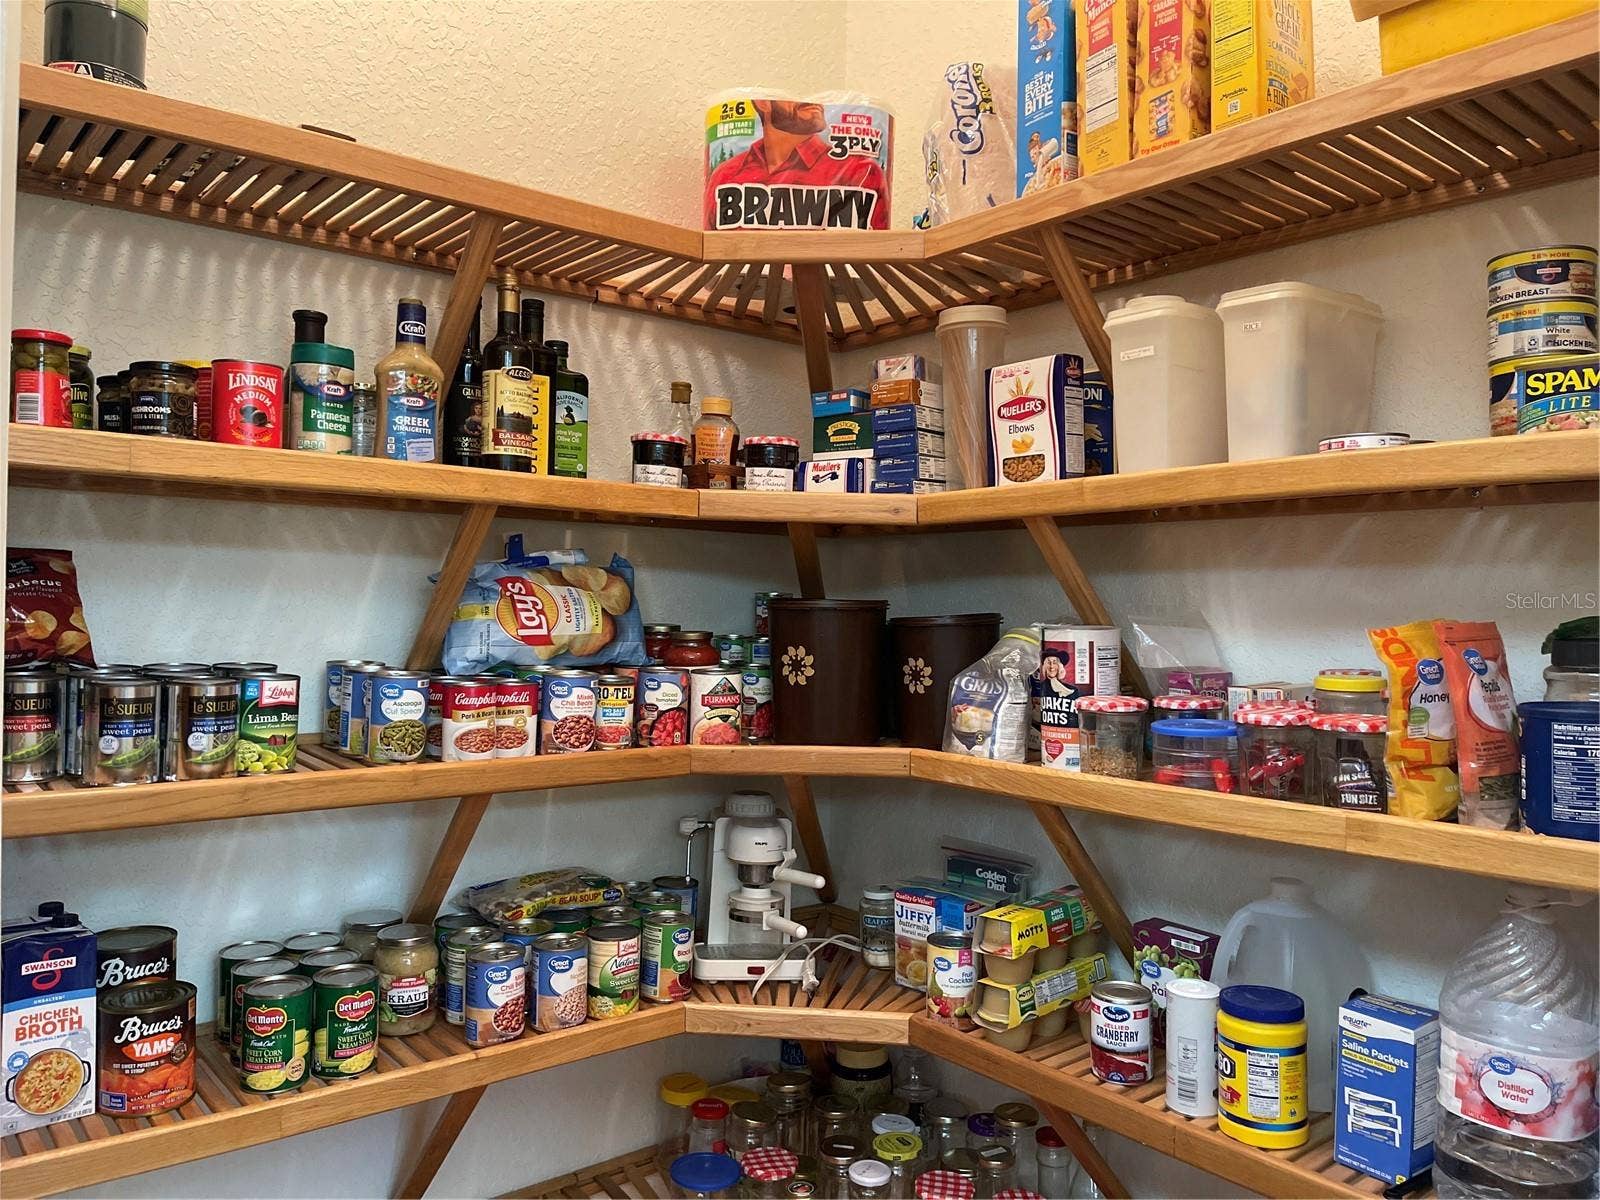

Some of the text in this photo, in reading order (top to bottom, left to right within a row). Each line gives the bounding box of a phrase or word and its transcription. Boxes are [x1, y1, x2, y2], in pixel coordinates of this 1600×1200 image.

[1025, 76, 1044, 92] BEST
[1045, 71, 1053, 83] IN
[1025, 80, 1053, 102] EVERY
[1025, 90, 1053, 116] BITE
[831, 125, 881, 138] THE ONLY
[829, 136, 880, 157] 3PLY
[717, 186, 875, 229] BRAWNY
[1515, 288, 1550, 298] BREAST
[404, 323, 424, 334] Kraft
[1527, 367, 1600, 396] SPAM
[326, 386, 345, 394] Kraft
[233, 391, 273, 408] MEDIUM
[406, 398, 421, 406] Kraft
[1549, 395, 1592, 413] LITE
[1000, 400, 1043, 418] MUELLER'S
[317, 419, 347, 432] Cheese
[395, 416, 430, 428] GREEK
[392, 424, 432, 435] VINAIGRETTE
[1008, 424, 1035, 435] Elbows
[812, 463, 840, 472] Mueller's
[8, 578, 62, 589] arbecue
[506, 582, 549, 636] Lay's
[561, 594, 573, 624] CLASSIC
[1420, 665, 1439, 674] Great
[266, 685, 295, 699] Libby's
[960, 677, 1002, 695] GRITS
[15, 699, 51, 711] SUEUR
[1420, 693, 1450, 704] Honey
[117, 702, 153, 715] SUEUR
[206, 701, 236, 712] SUEUR
[248, 714, 278, 724] Lima
[1042, 711, 1068, 725] OATS
[30, 723, 52, 732] peas
[102, 728, 152, 736] sweet peas
[191, 724, 236, 733] sweet peas
[1341, 793, 1378, 805] FUN SIZE
[976, 868, 1007, 883] Golden
[987, 880, 1007, 892] Dipt
[558, 893, 599, 905] BEAN SOUP
[895, 891, 912, 901] Quality
[896, 905, 933, 924] JIFFY
[1051, 907, 1063, 915] APPLE
[898, 920, 931, 932] buttermilk
[1017, 924, 1044, 940] MOTT'S
[24, 958, 73, 973] SWANSON
[97, 957, 170, 988] Bruce's
[500, 984, 514, 992] Chili
[609, 979, 631, 987] Sweet
[388, 991, 429, 1003] KRAUT
[1018, 988, 1034, 998] MOTT'S
[339, 998, 373, 1011] Del Monte
[19, 1006, 79, 1025] CHICKEN
[258, 1016, 284, 1024] Monte
[1343, 1015, 1369, 1027] equate
[15, 1016, 83, 1041] BROTH
[114, 1016, 182, 1044] Bruce's
[1096, 1025, 1139, 1042] CRANBERRY
[1103, 1023, 1130, 1031] JELLIED
[337, 1036, 373, 1049] CREAM STYLE
[338, 1030, 373, 1043] SWEET CORN
[132, 1036, 174, 1057] YAMS
[263, 1049, 283, 1057] CORN
[1342, 1039, 1370, 1055] Saline
[1371, 1049, 1409, 1069] Packets
[1491, 1059, 1511, 1070] Great
[1497, 1080, 1534, 1096] Distilled
[1501, 1090, 1529, 1104] Water
